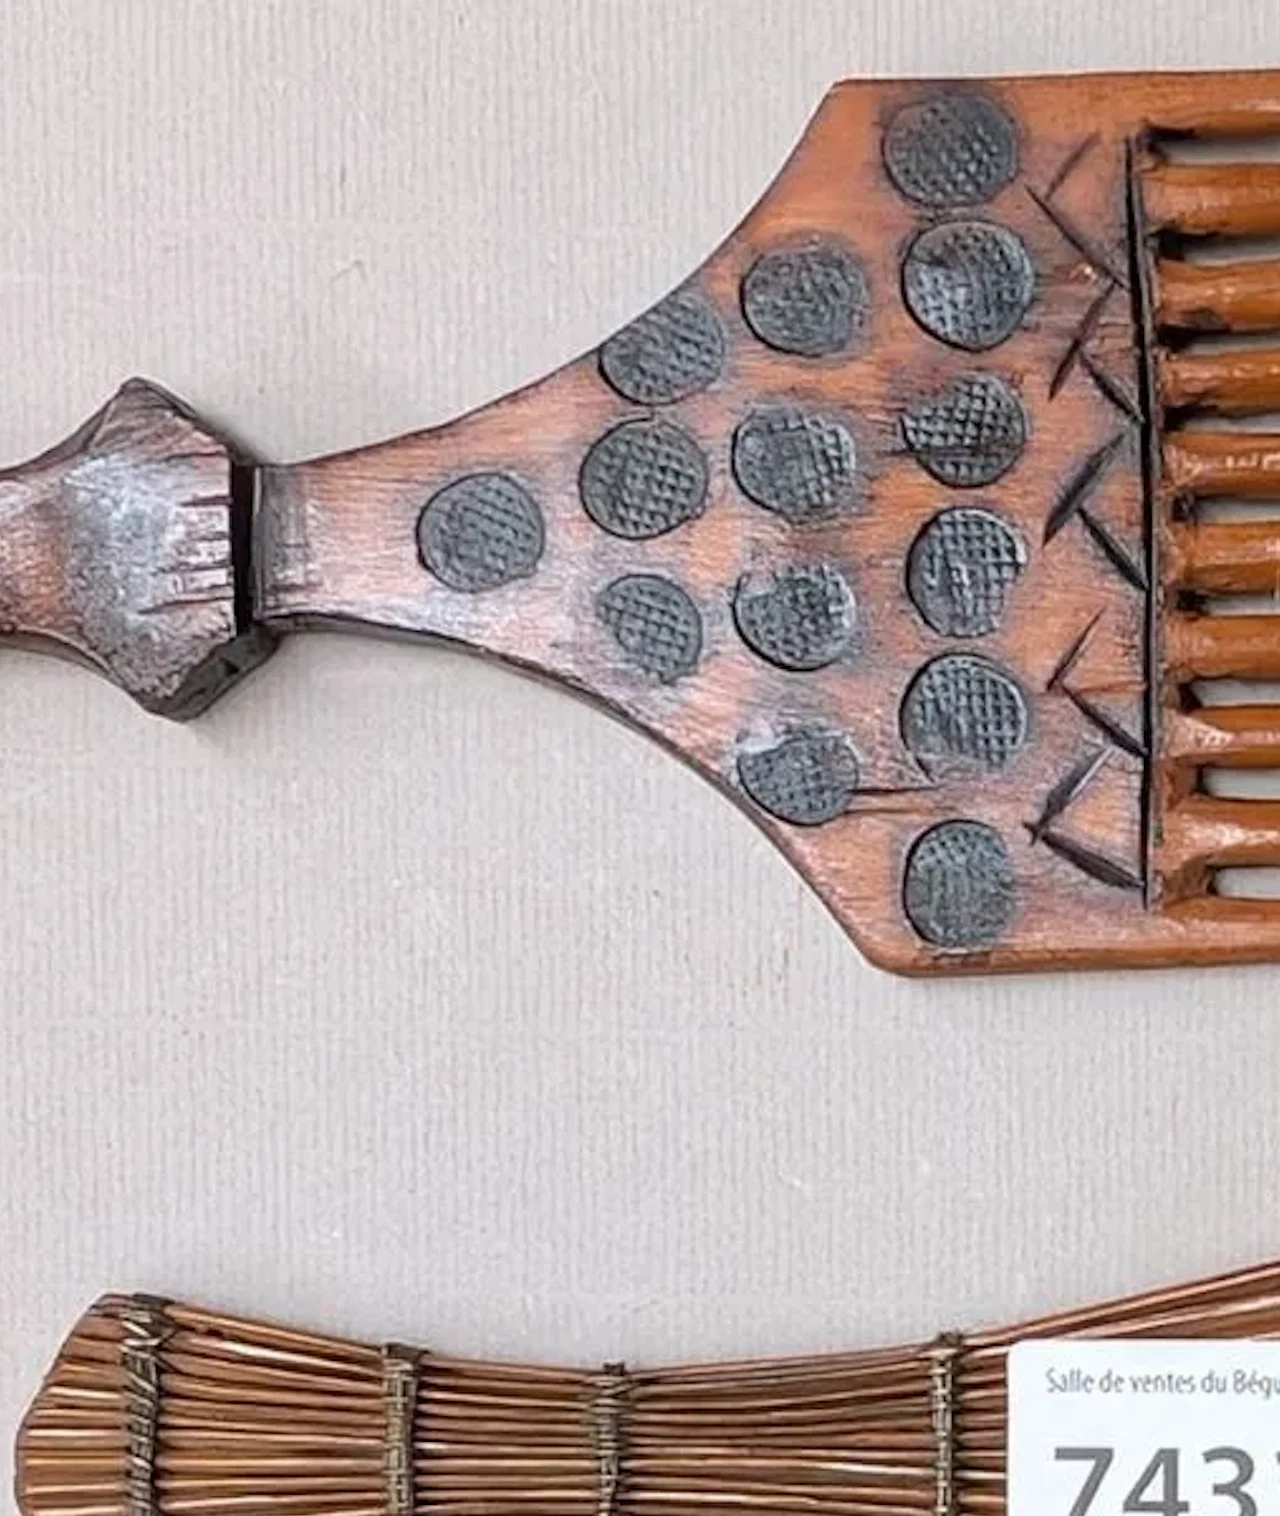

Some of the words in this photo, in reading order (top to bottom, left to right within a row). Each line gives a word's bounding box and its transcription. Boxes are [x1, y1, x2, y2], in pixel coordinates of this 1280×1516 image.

[1045, 1367, 1095, 1395] Salle
[1101, 1368, 1124, 1395] de
[1130, 1370, 1197, 1395] ventes
[1201, 1368, 1227, 1395] du
